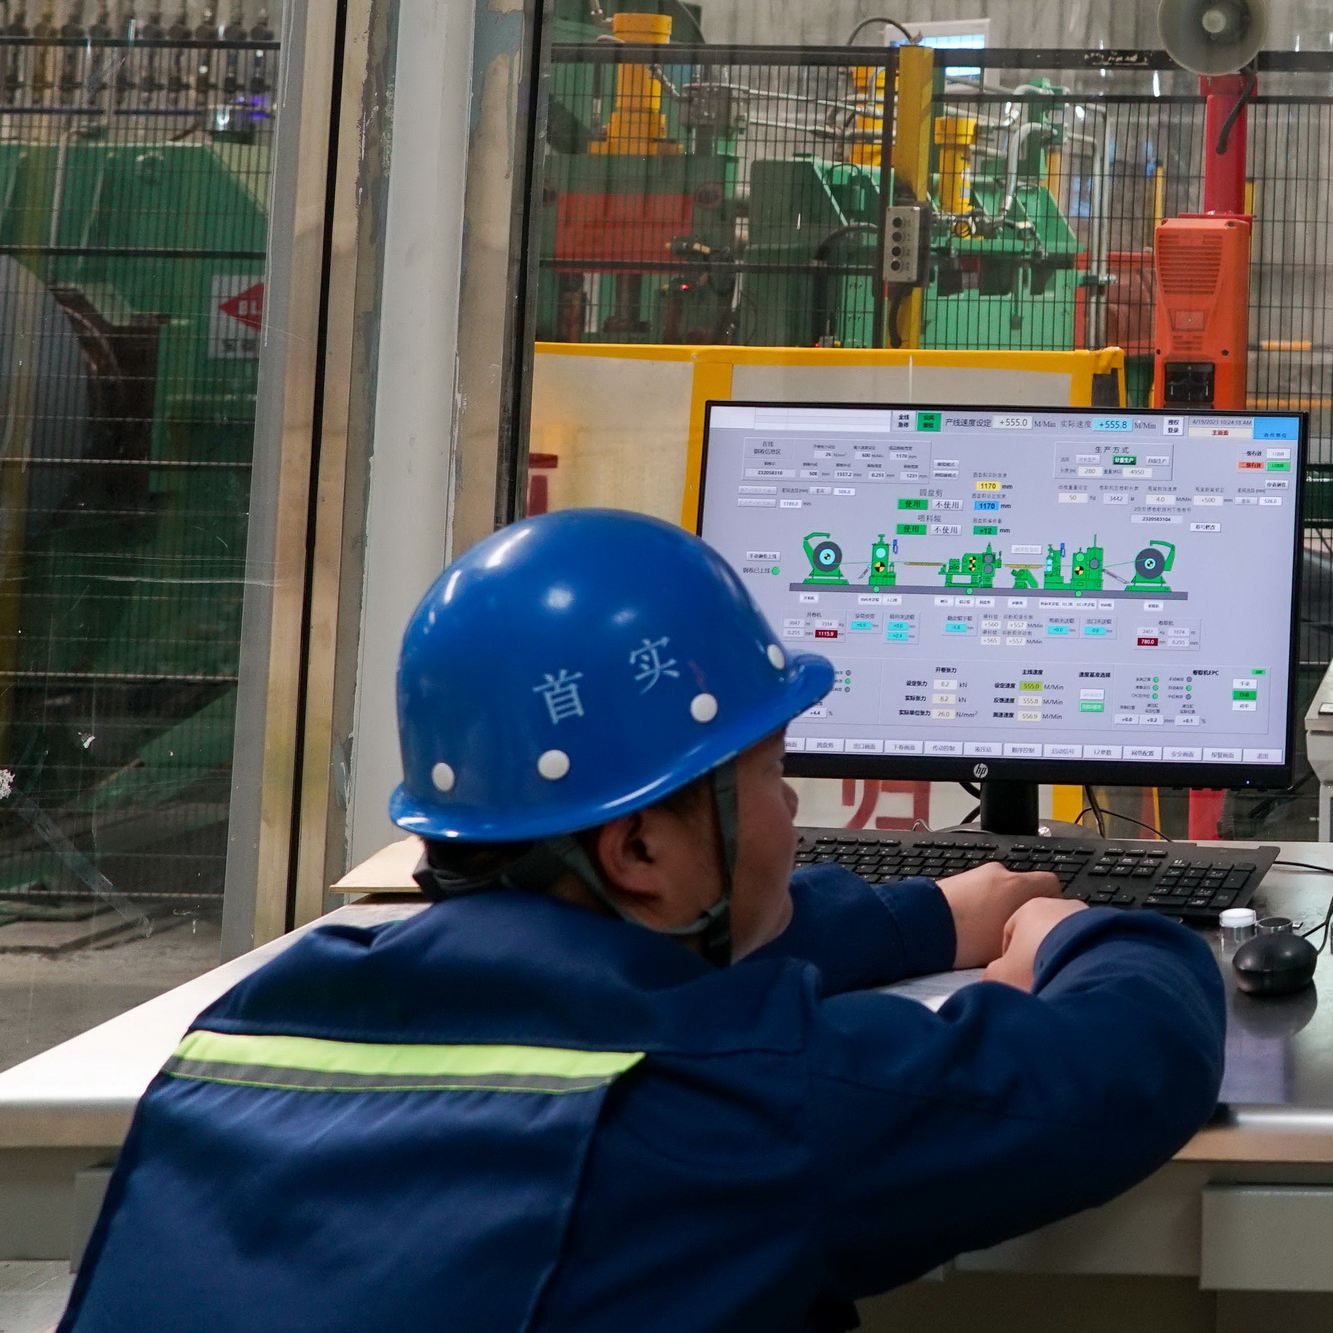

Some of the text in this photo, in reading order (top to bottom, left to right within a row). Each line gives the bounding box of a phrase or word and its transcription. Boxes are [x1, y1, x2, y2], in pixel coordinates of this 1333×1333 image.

[945, 418, 992, 428] 产线速度设定
[1000, 418, 1028, 427] +555.0
[1060, 419, 1091, 429] 实际速度
[1099, 420, 1128, 429] +555.8
[1095, 446, 1130, 454] 生产方式
[905, 500, 959, 509] 使用 不使用
[903, 525, 958, 534] 使用 不使用
[973, 763, 989, 779] hp
